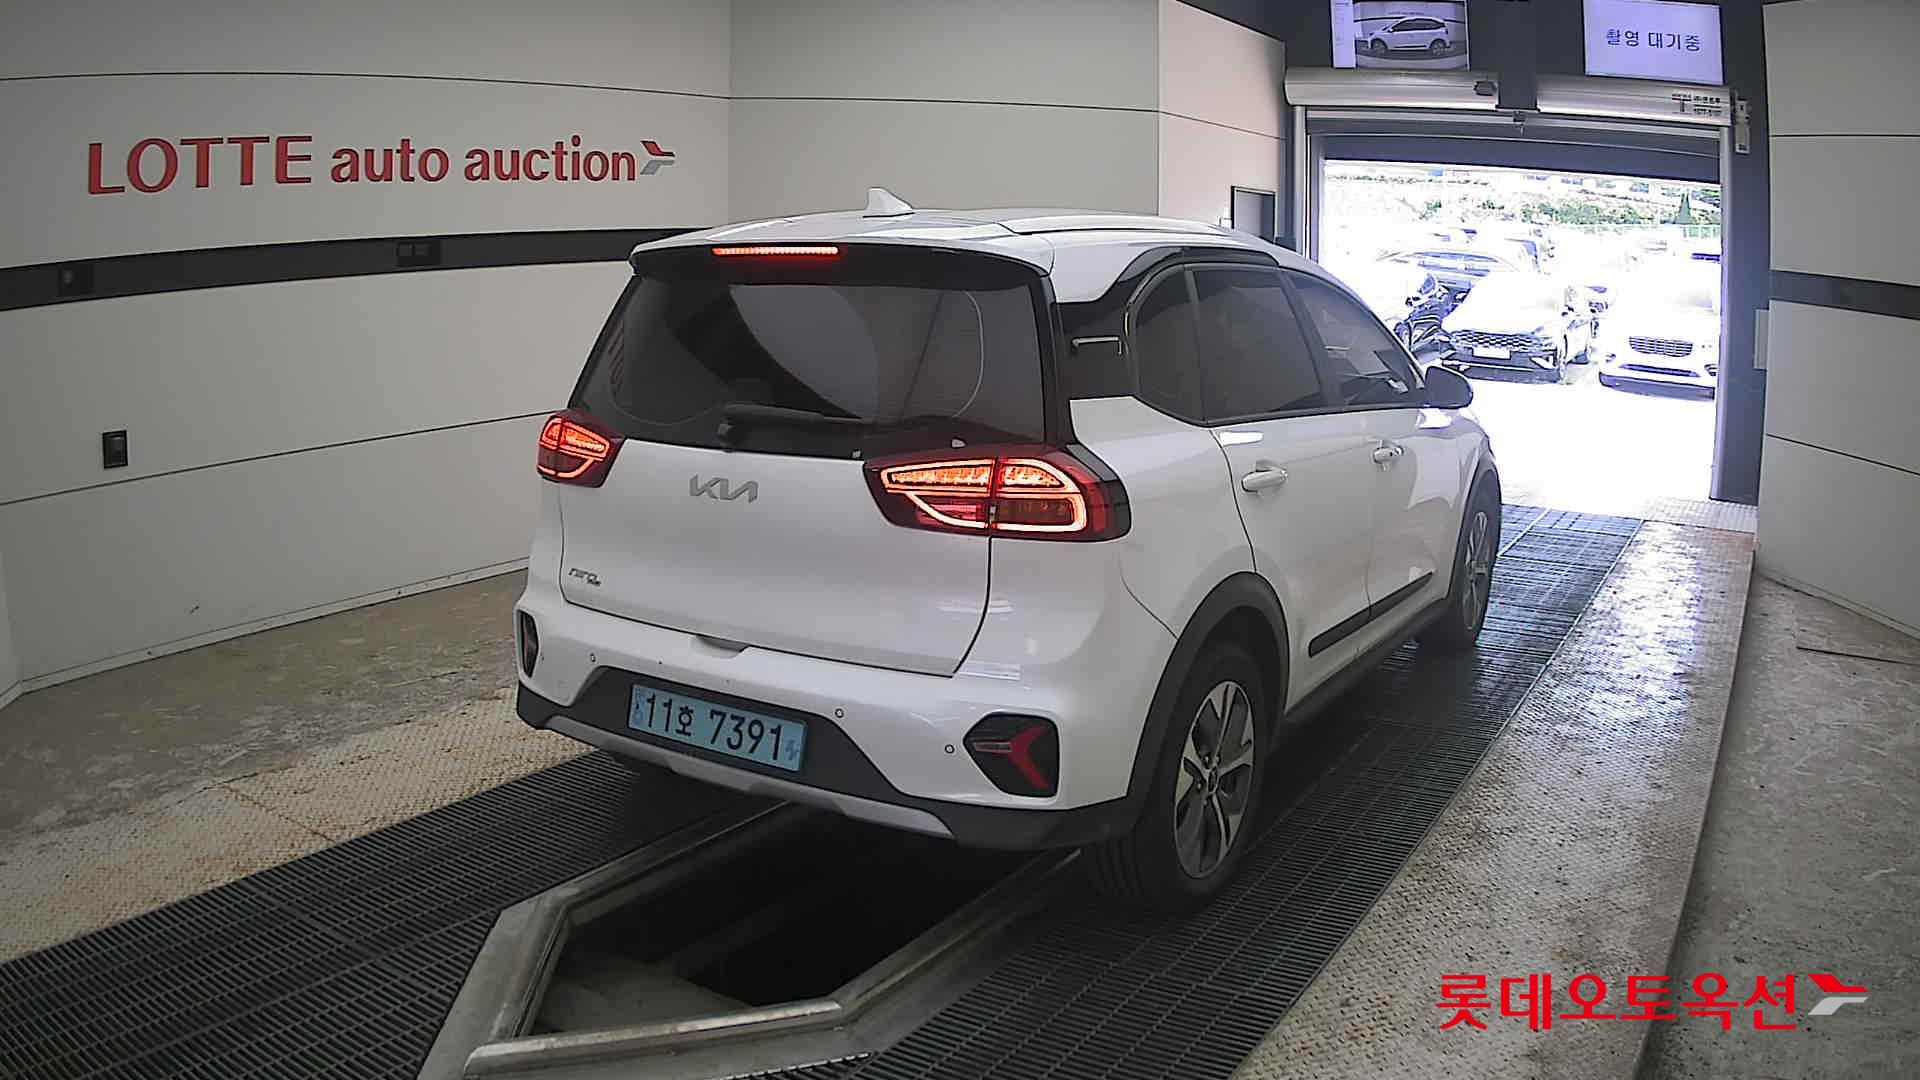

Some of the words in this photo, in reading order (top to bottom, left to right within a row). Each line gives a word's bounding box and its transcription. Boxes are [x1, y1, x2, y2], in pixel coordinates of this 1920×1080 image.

[1647, 32, 1700, 51] 대기중
[87, 136, 312, 194] LOTTE
[330, 138, 449, 182] auto
[464, 135, 636, 181] auction
[647, 693, 694, 737] 11호
[710, 709, 782, 761] 7391
